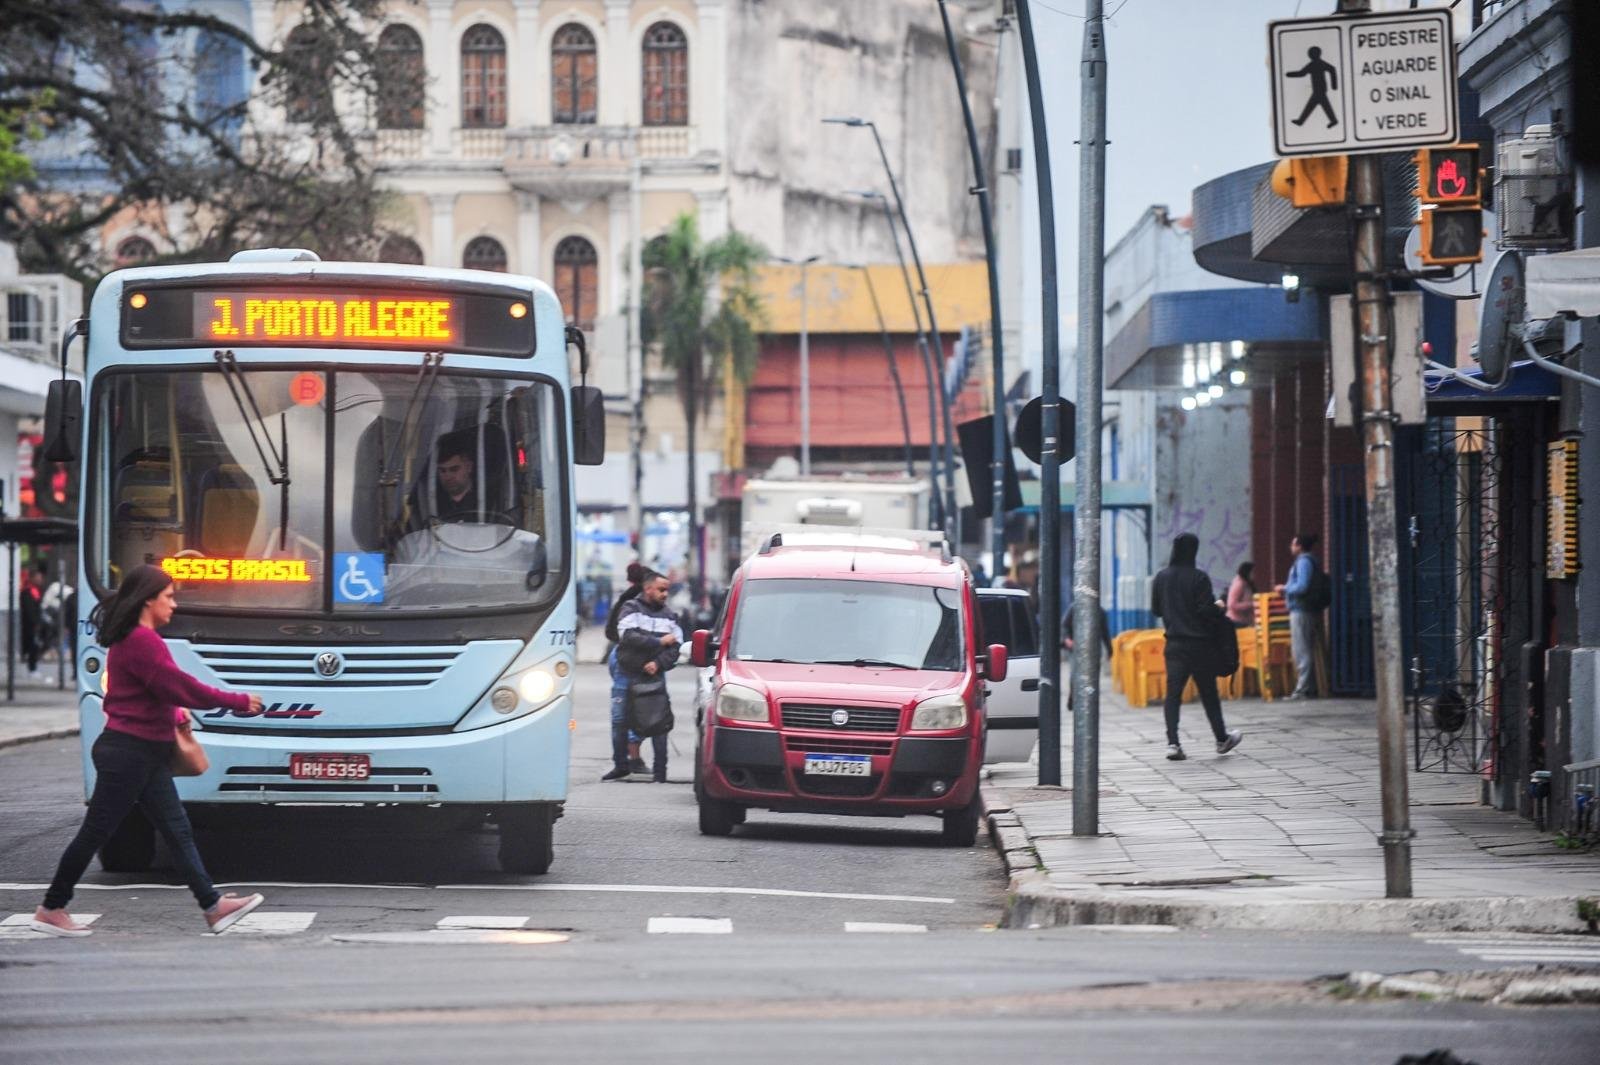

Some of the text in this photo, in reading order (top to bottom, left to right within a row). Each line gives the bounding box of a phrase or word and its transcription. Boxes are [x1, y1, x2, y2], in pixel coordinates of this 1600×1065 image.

[1357, 28, 1438, 48] PEDESTRE
[1361, 56, 1437, 76] AGUARDE
[1370, 85, 1431, 103] O SINAL
[1375, 112, 1428, 130] VERDE
[245, 299, 338, 336] PORTO
[343, 301, 450, 338] ALEGRE
[300, 379, 318, 400] B
[161, 557, 312, 582] ASSIS BRASIL
